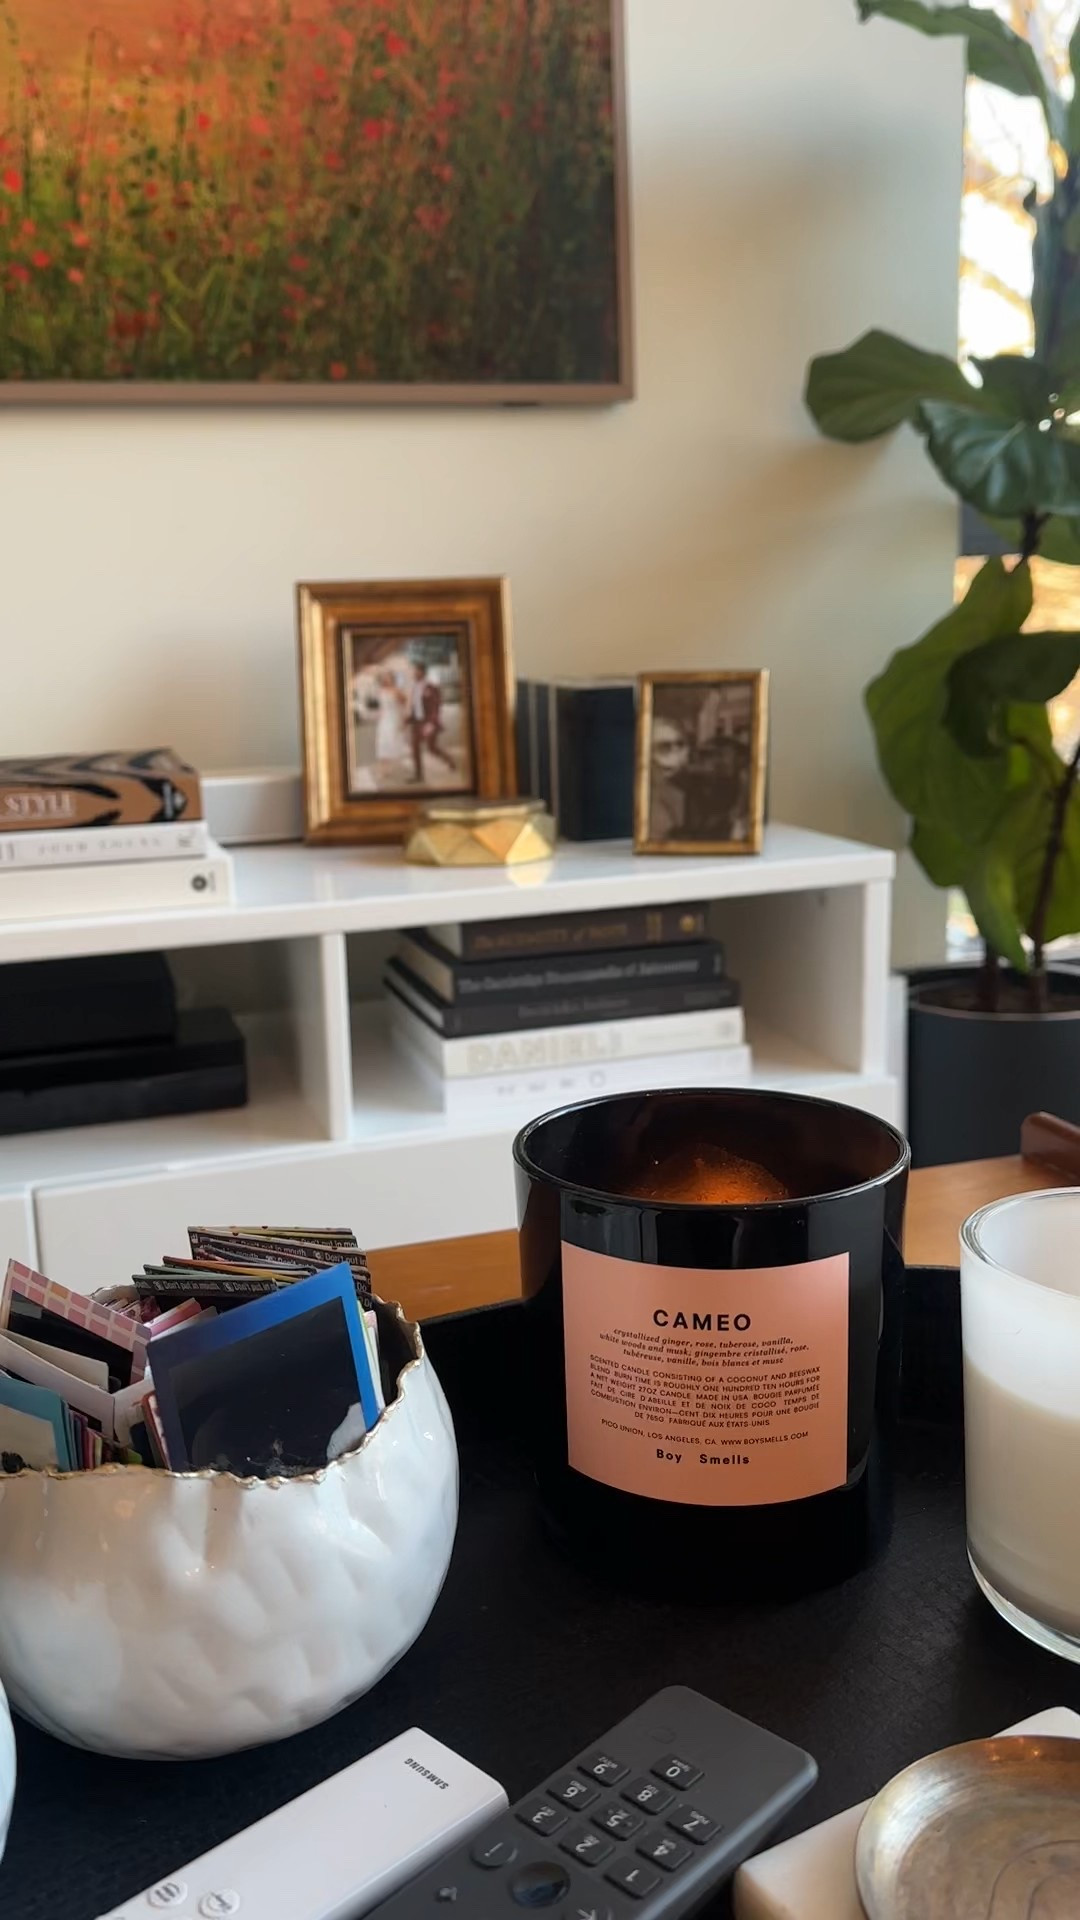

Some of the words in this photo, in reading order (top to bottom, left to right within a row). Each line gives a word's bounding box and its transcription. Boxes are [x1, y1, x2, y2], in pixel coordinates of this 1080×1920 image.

[653, 1309, 751, 1331] CAMEO
[599, 1333, 620, 1344] white
[621, 1339, 646, 1350] woods
[648, 1345, 664, 1353] and
[694, 1349, 741, 1359] gingembre
[614, 1329, 660, 1343] crystallized
[661, 1337, 693, 1348] ginger,
[695, 1341, 717, 1349] rose,
[719, 1340, 759, 1349] tuberose,
[761, 1337, 794, 1347] vanilla,
[589, 1354, 620, 1369] SCENTED
[621, 1364, 650, 1377] CANDLE
[652, 1370, 702, 1383] CONSISTING
[726, 1375, 769, 1383] COCONUT
[770, 1370, 787, 1381] AND
[789, 1366, 821, 1379] BEESWAX
[666, 1356, 699, 1367] vanille,
[701, 1358, 719, 1367] bois
[721, 1358, 750, 1367] blancs
[751, 1358, 761, 1366] et
[762, 1357, 784, 1366] musc
[596, 1373, 609, 1383] NET
[610, 1379, 636, 1391] WEIGHT
[659, 1390, 691, 1400] CANDLE
[753, 1391, 783, 1400] BOUGIE
[784, 1384, 820, 1397] PARFUMÉE
[614, 1370, 633, 1381] BURN
[634, 1376, 651, 1386] TIME
[653, 1379, 662, 1387] IS
[663, 1381, 701, 1391] ROUGHLY
[722, 1384, 760, 1393] HUNDRED
[762, 1383, 778, 1391] TEN
[779, 1379, 804, 1389] HOURS
[806, 1375, 821, 1385] FOR
[590, 1380, 604, 1390] FAIT
[607, 1386, 616, 1394] DE
[620, 1390, 636, 1400] CIRE
[640, 1394, 677, 1407] DABEILLE
[711, 1402, 731, 1410] NOIX
[783, 1396, 807, 1406] TEMPS
[811, 1393, 820, 1401] DE
[590, 1388, 636, 1408] COMBUSTION
[702, 1411, 717, 1419] DIX
[718, 1411, 749, 1419] HEURES
[751, 1410, 774, 1418] POUR
[775, 1408, 791, 1416] UNE
[793, 1401, 820, 1414] BOUGIE
[634, 1411, 644, 1419] DE
[668, 1417, 706, 1428] FABRIQUÉ
[708, 1420, 725, 1428] AUX
[601, 1418, 618, 1429] PICO
[619, 1424, 646, 1438] UNION,
[647, 1431, 663, 1440] LOS
[656, 1448, 682, 1464] Boy
[699, 1453, 750, 1465] Smells
[404, 1757, 449, 1790] SAMSUNG
[593, 1763, 608, 1774] 9
[665, 1766, 681, 1778] 0
[563, 1786, 579, 1798] 6
[637, 1790, 652, 1802] 8
[532, 1811, 548, 1824] 3
[606, 1814, 624, 1827] 5
[682, 1820, 700, 1831] 7
[575, 1840, 593, 1853] 2
[653, 1844, 669, 1856] 4
[625, 1869, 640, 1882] 1
